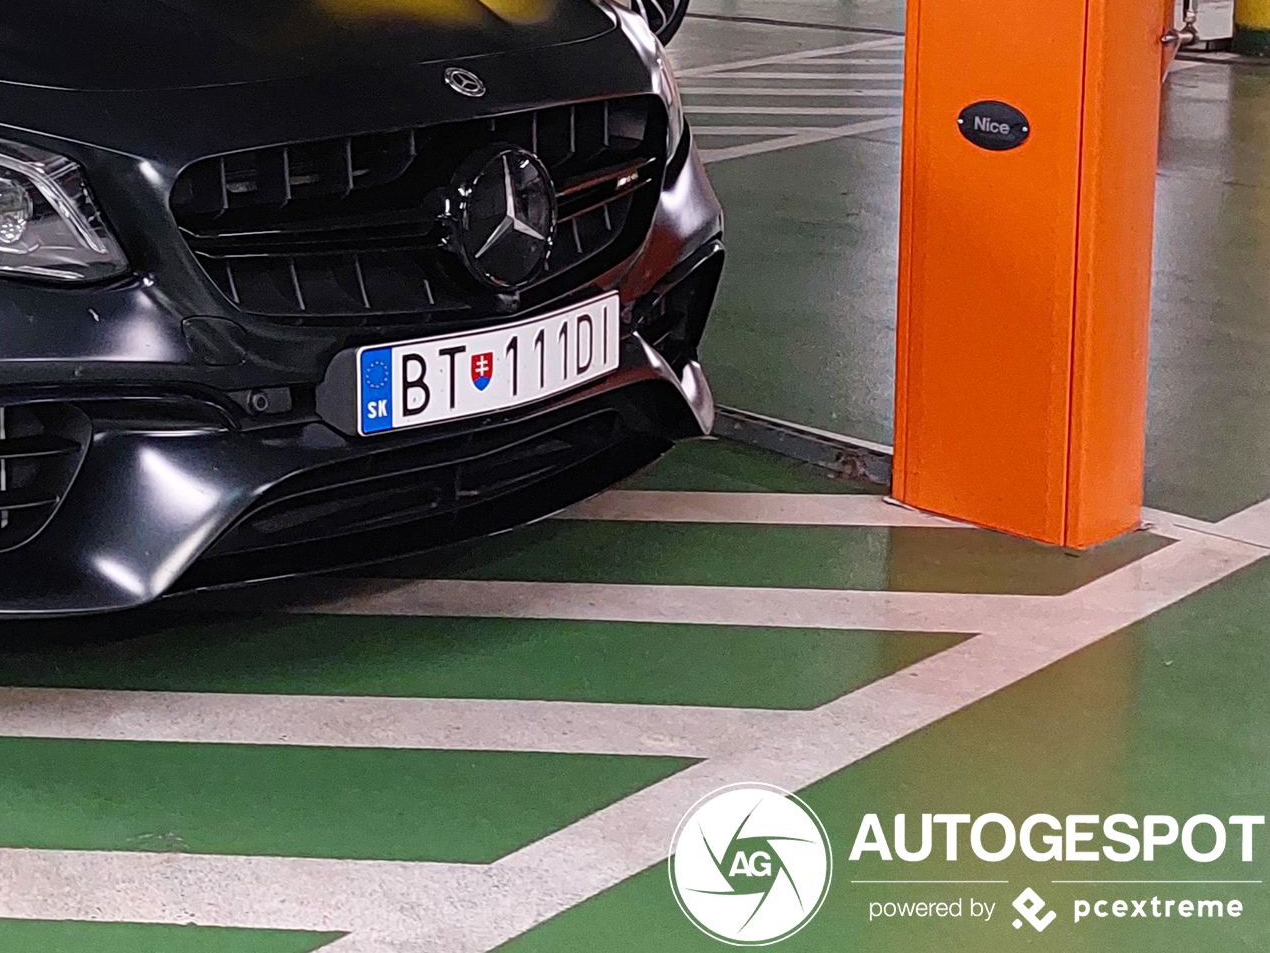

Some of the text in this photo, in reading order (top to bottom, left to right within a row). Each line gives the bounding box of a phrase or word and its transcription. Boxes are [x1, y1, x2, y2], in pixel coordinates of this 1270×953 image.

[973, 115, 1011, 135] Nice
[401, 305, 609, 417] BT 111DI
[367, 399, 388, 419] SK
